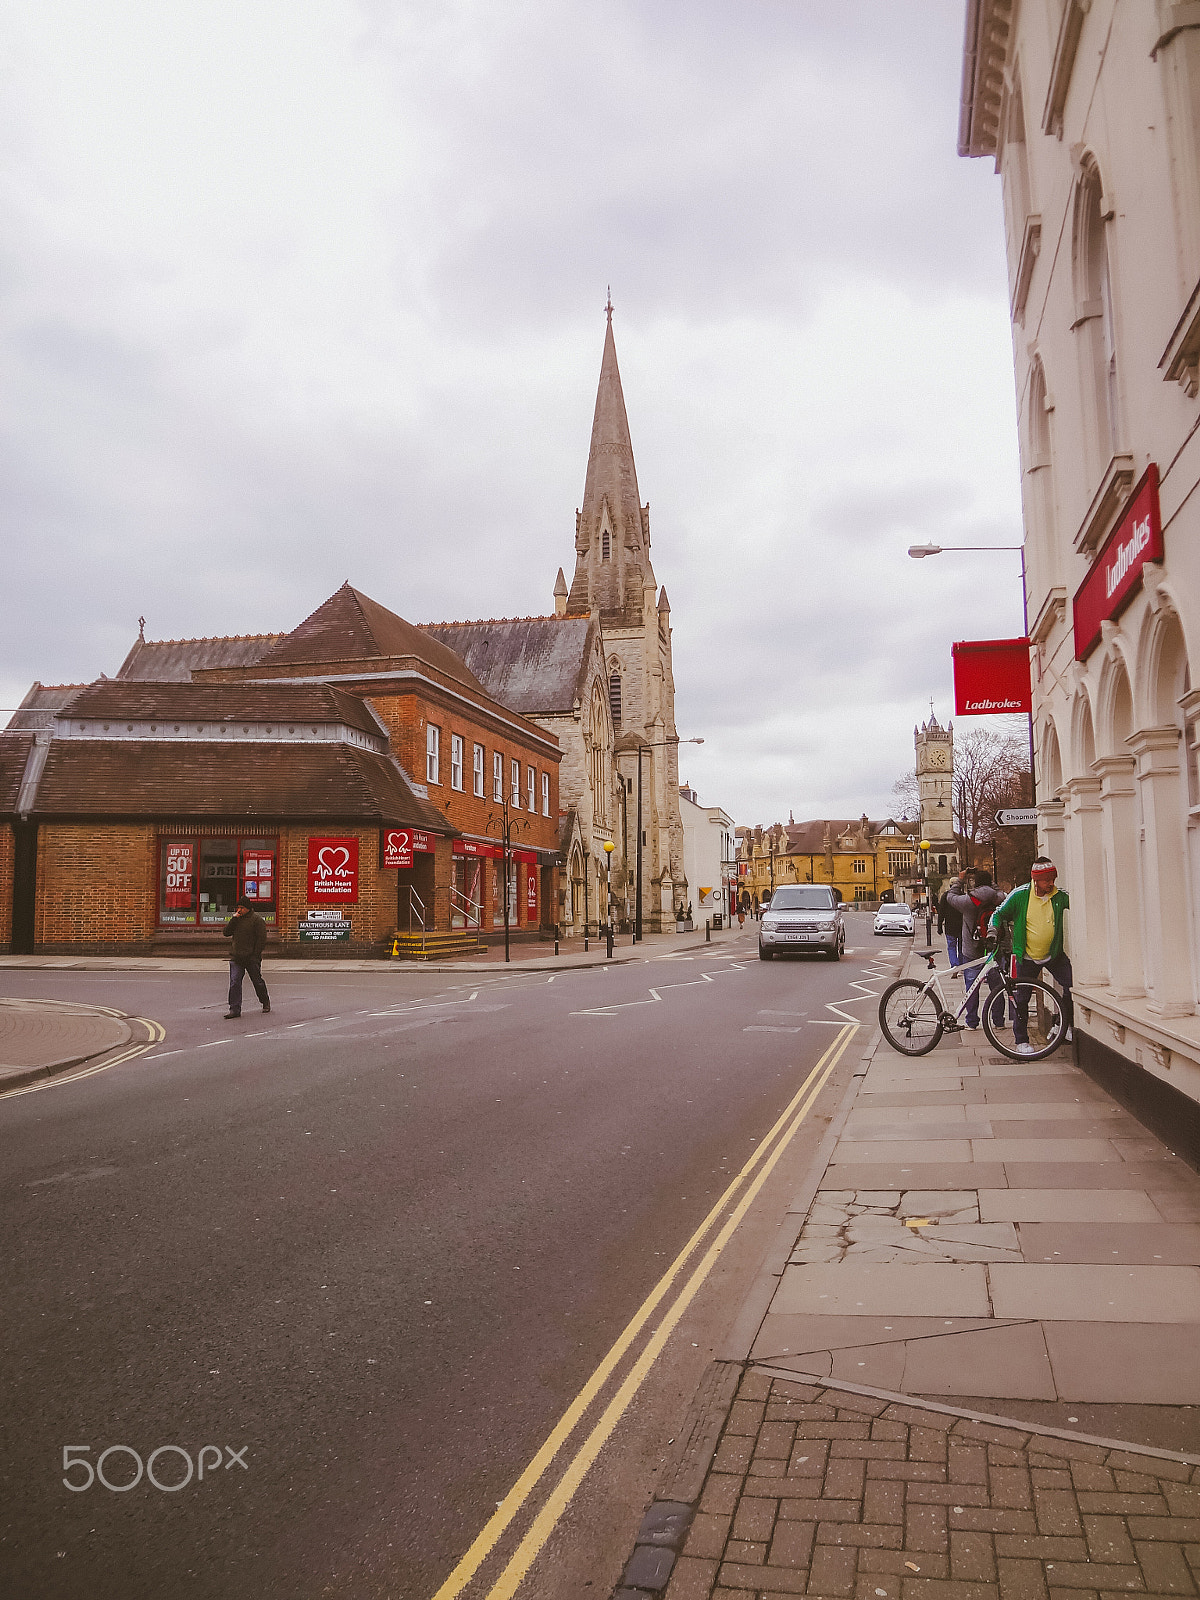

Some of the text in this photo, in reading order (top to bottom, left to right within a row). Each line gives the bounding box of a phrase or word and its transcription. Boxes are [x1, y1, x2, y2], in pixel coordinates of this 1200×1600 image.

[1106, 513, 1151, 599] Ladbrokes
[965, 698, 1022, 710] Ladbrokes
[166, 874, 192, 887] OFF
